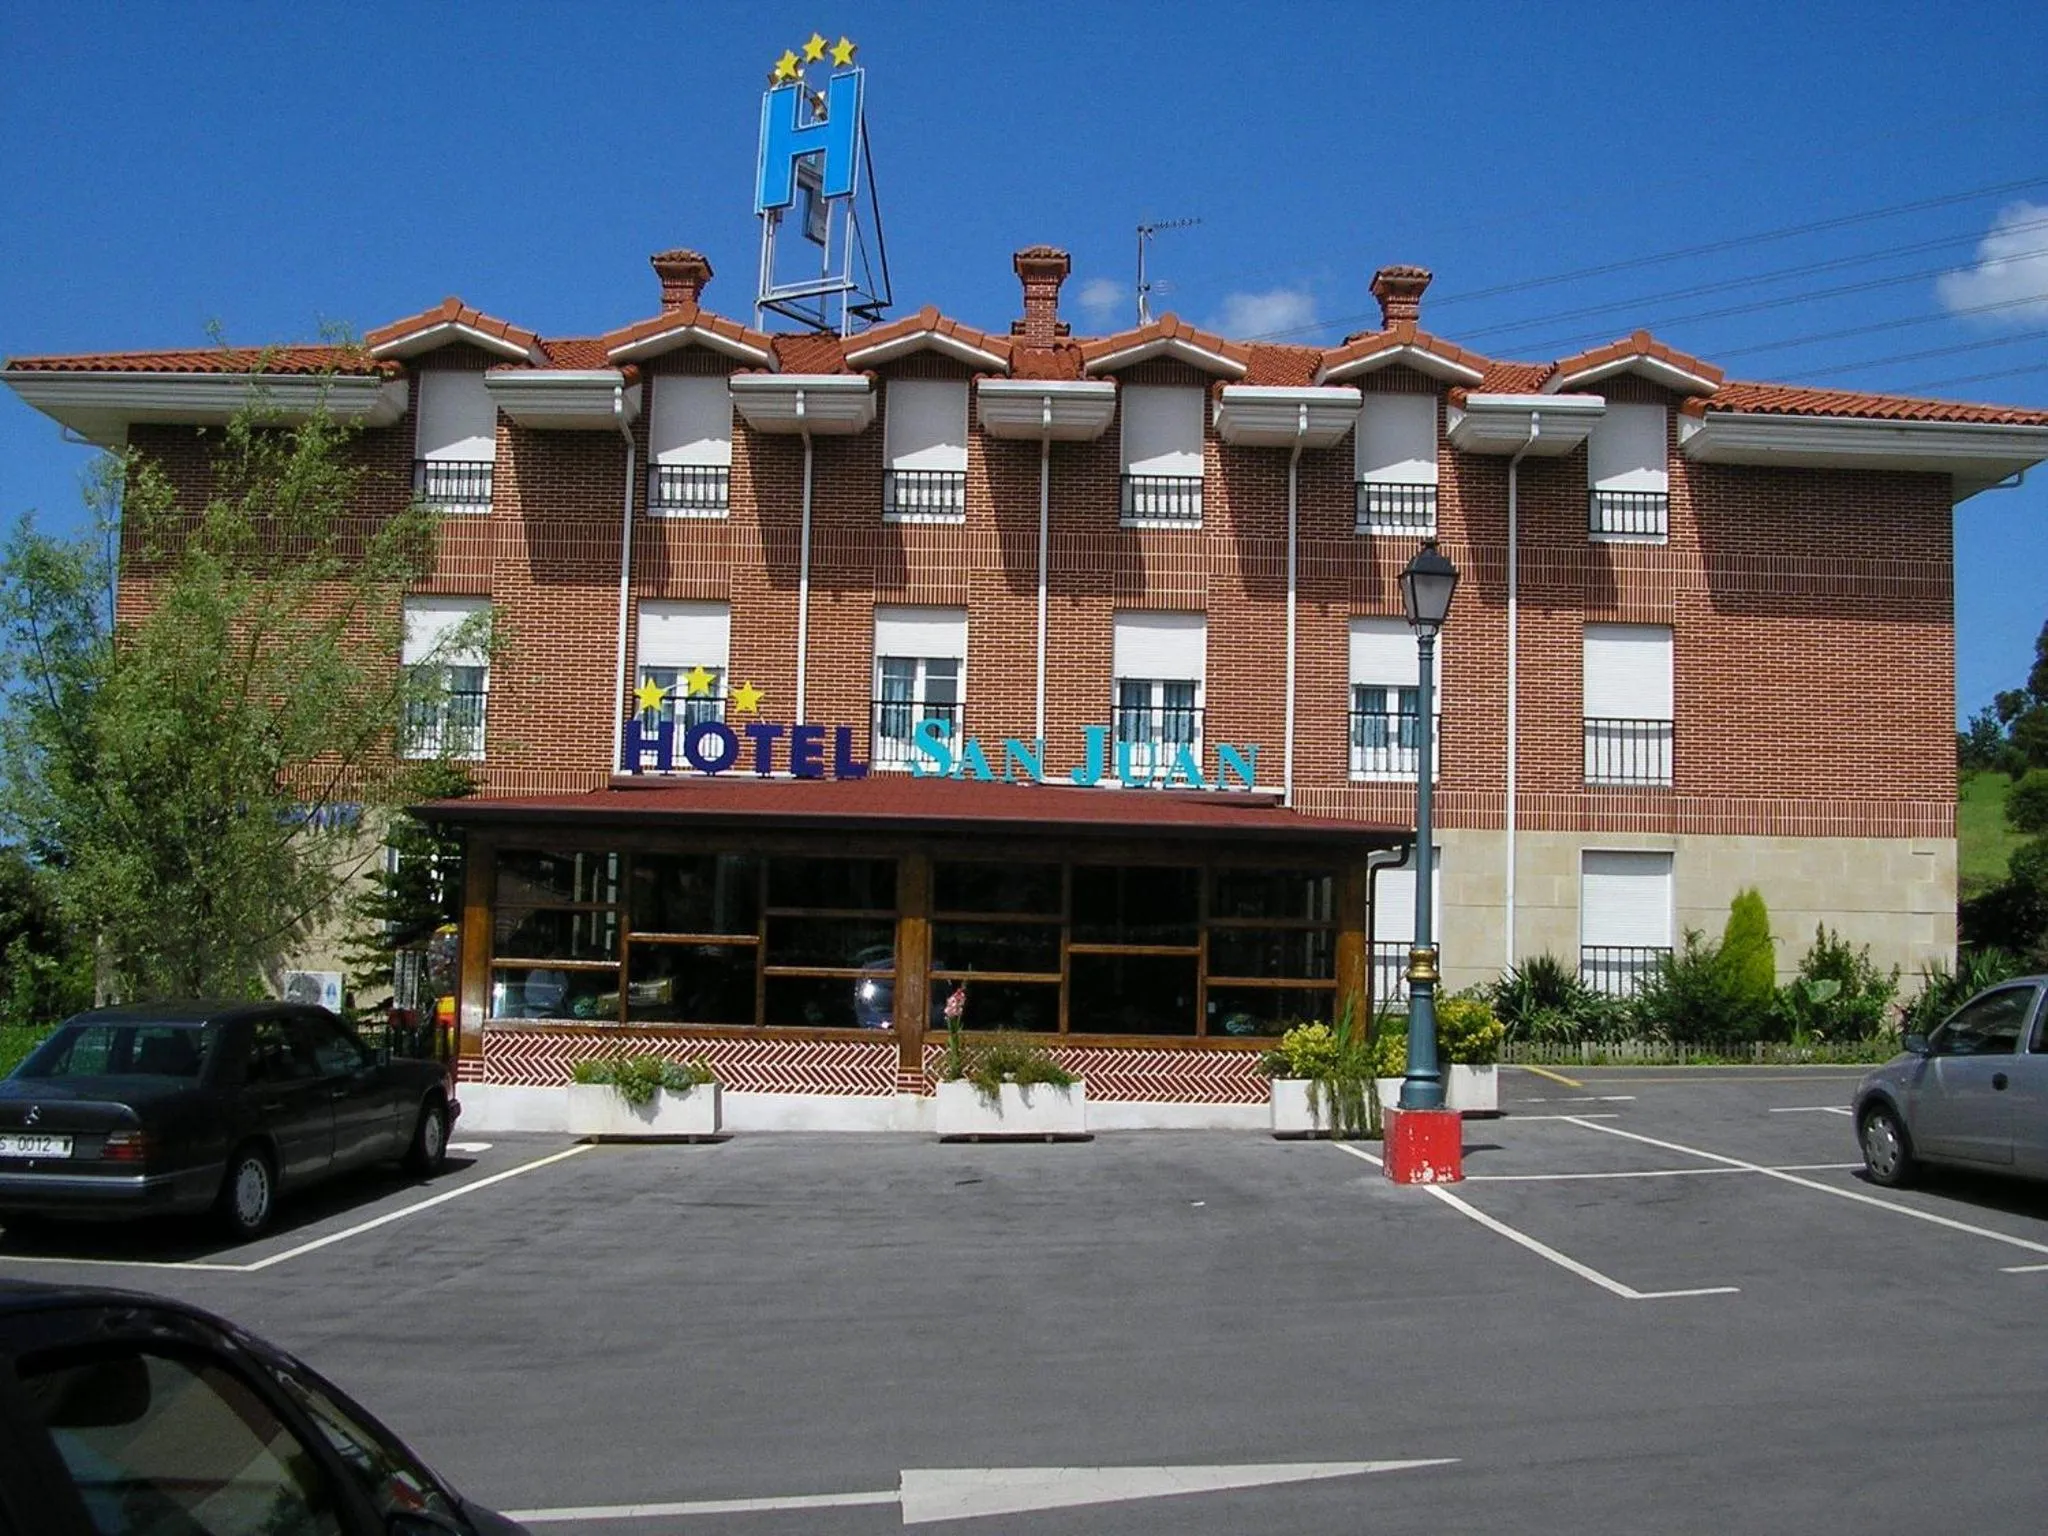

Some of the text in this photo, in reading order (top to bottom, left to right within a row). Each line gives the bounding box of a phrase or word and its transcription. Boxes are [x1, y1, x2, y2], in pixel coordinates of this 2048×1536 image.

[755, 67, 865, 216] H
[624, 717, 1261, 791] HOTEL SAN JUAN
[17, 1135, 52, 1152] 0012
